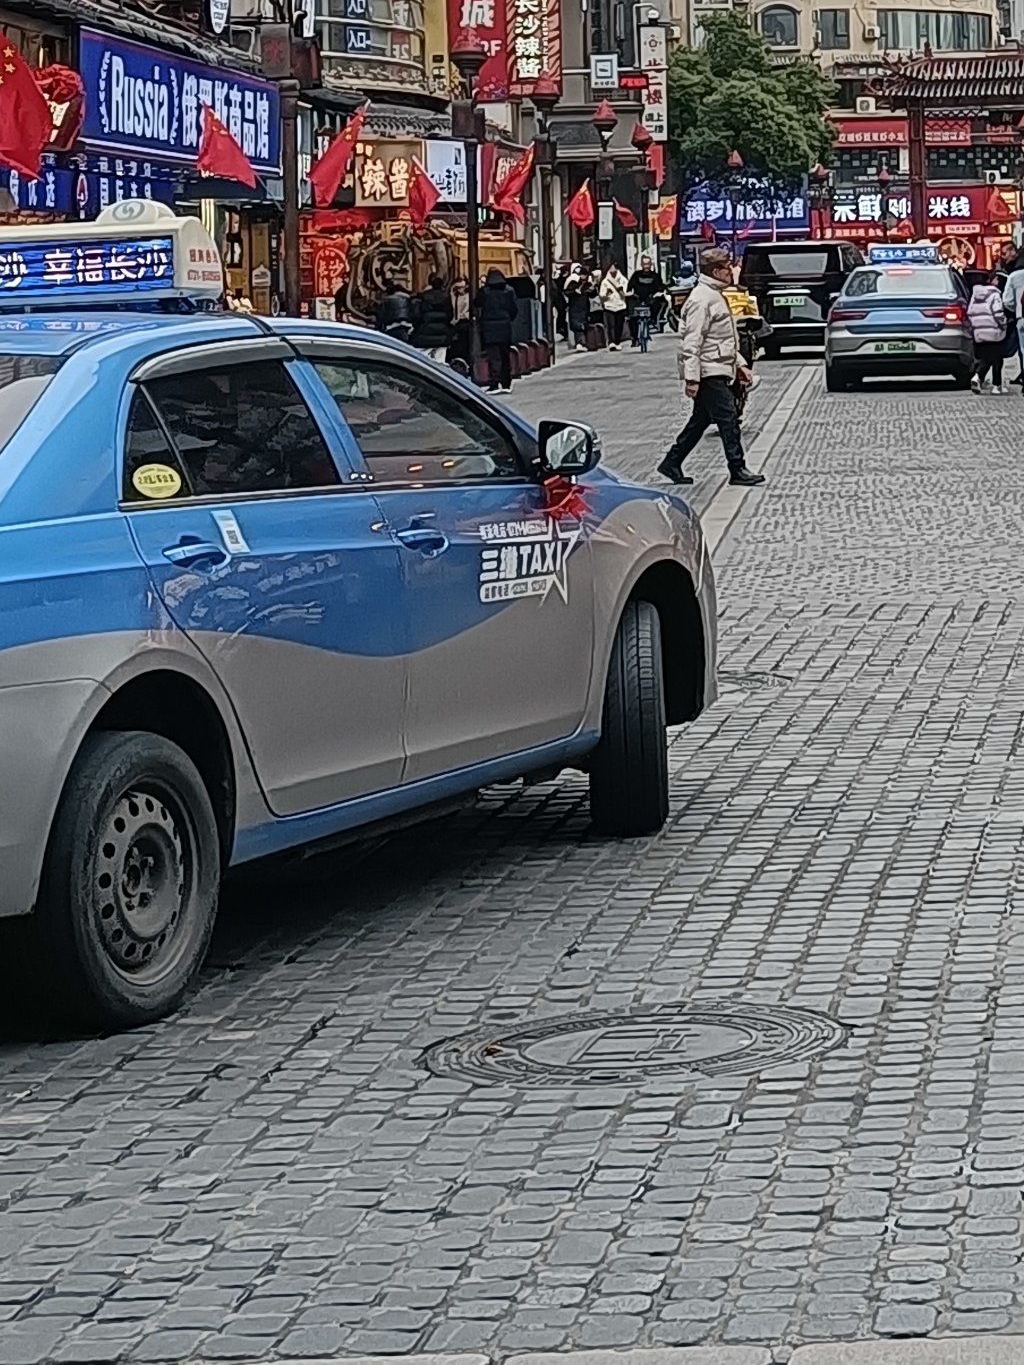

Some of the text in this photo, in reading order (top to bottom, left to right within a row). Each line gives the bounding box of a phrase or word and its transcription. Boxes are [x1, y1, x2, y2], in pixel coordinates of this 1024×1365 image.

[111, 55, 169, 141] Russia
[362, 157, 409, 201] 辣酱
[928, 196, 970, 218] 米线
[43, 244, 168, 285] 幸福长沙
[520, 541, 562, 575] TAXI
